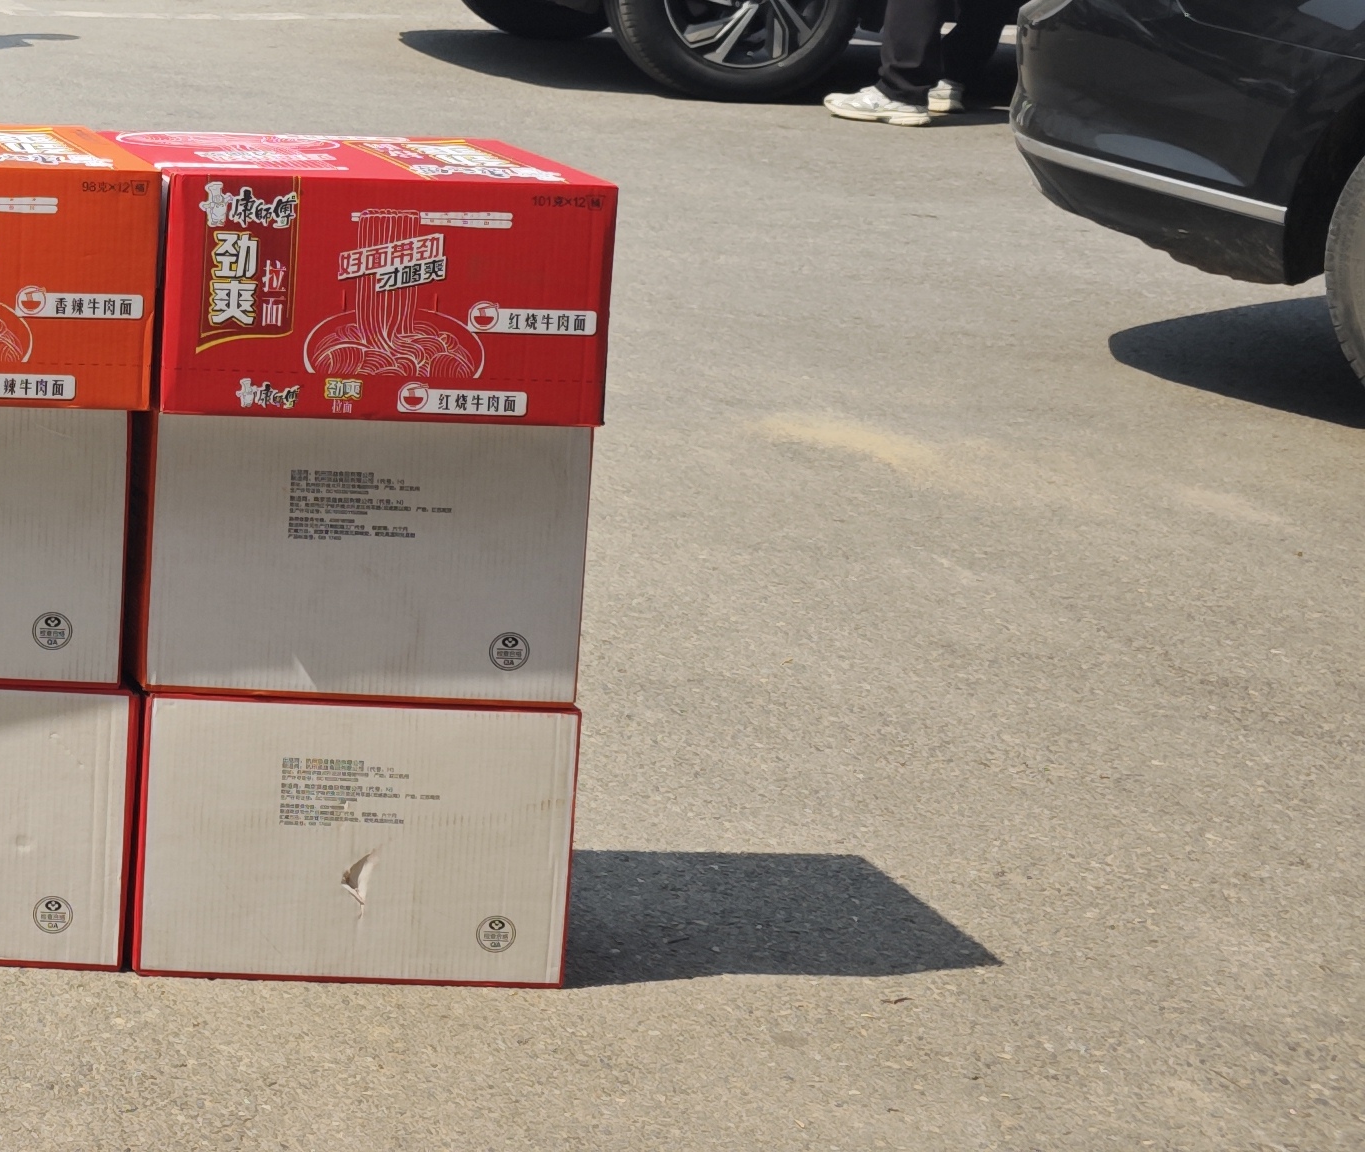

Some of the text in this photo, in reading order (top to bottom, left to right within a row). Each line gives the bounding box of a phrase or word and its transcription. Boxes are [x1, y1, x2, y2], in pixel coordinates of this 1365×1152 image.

[231, 188, 297, 227] 康師傅
[339, 234, 445, 279] 好面带劲
[210, 232, 258, 326] 劲爽
[377, 257, 446, 291] 才够爽
[54, 297, 133, 317] 香辣牛肉面
[262, 260, 287, 327] 拉面
[507, 313, 587, 333] 红烧牛肉面
[325, 380, 363, 399] 劲爽
[439, 393, 517, 413] 红烧牛肉面
[332, 399, 353, 414] 拉面
